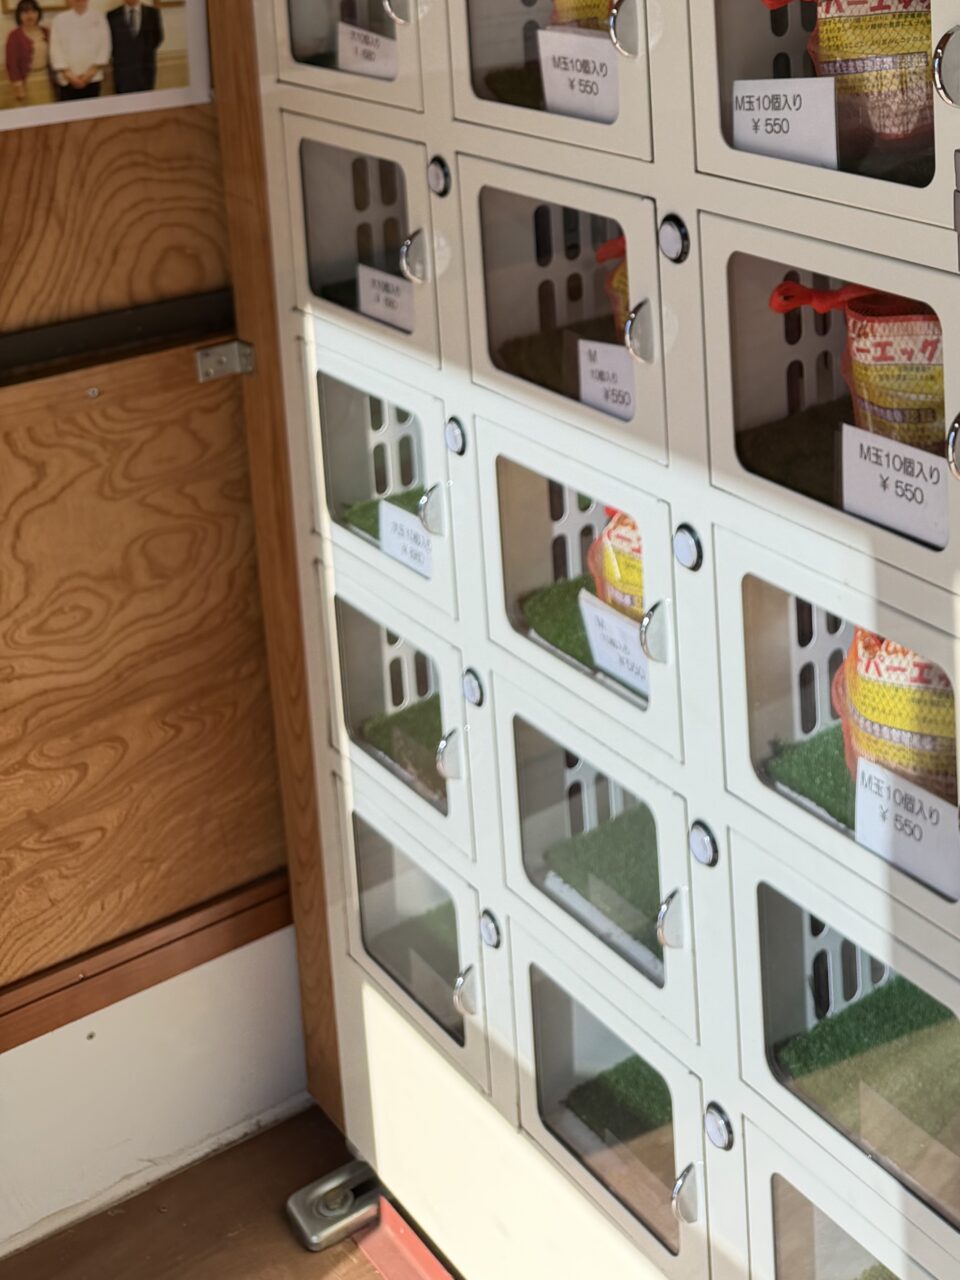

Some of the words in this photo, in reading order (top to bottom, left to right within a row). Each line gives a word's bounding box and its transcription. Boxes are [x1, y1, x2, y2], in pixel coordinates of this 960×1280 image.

[552, 55, 608, 78] M玉10個入り
[735, 93, 803, 112] M玉10個入り
[859, 443, 941, 484] M玉10個入り
[861, 772, 940, 824] M玉10個入り
